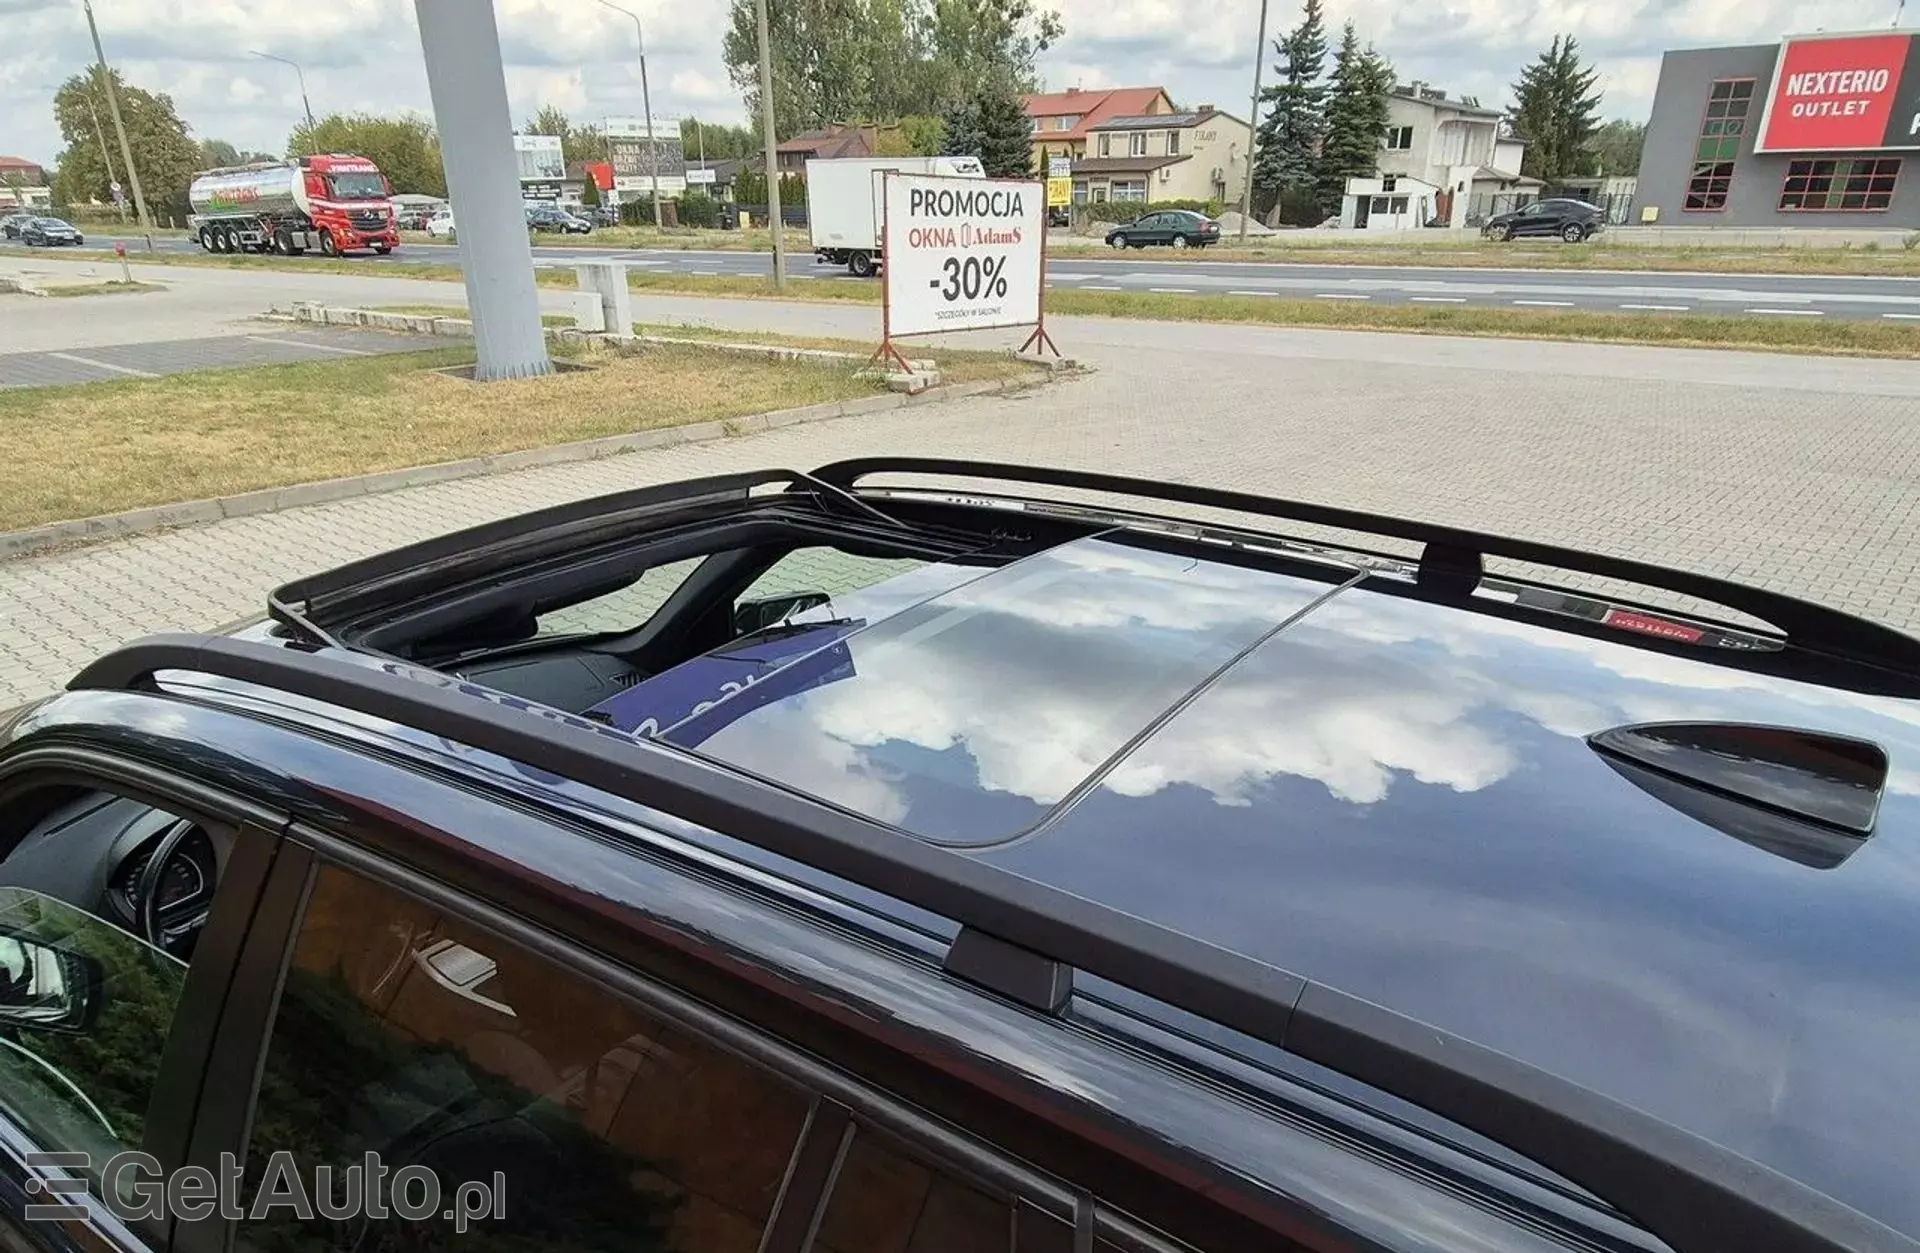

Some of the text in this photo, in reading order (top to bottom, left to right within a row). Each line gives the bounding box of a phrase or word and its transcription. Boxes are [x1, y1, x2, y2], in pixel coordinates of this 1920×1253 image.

[1786, 69, 1889, 96] NEXTERIO
[1792, 99, 1872, 118] OUTLET
[910, 188, 1024, 217] PROMOCJA
[908, 228, 956, 248] OKNA
[929, 255, 1008, 302] -30%
